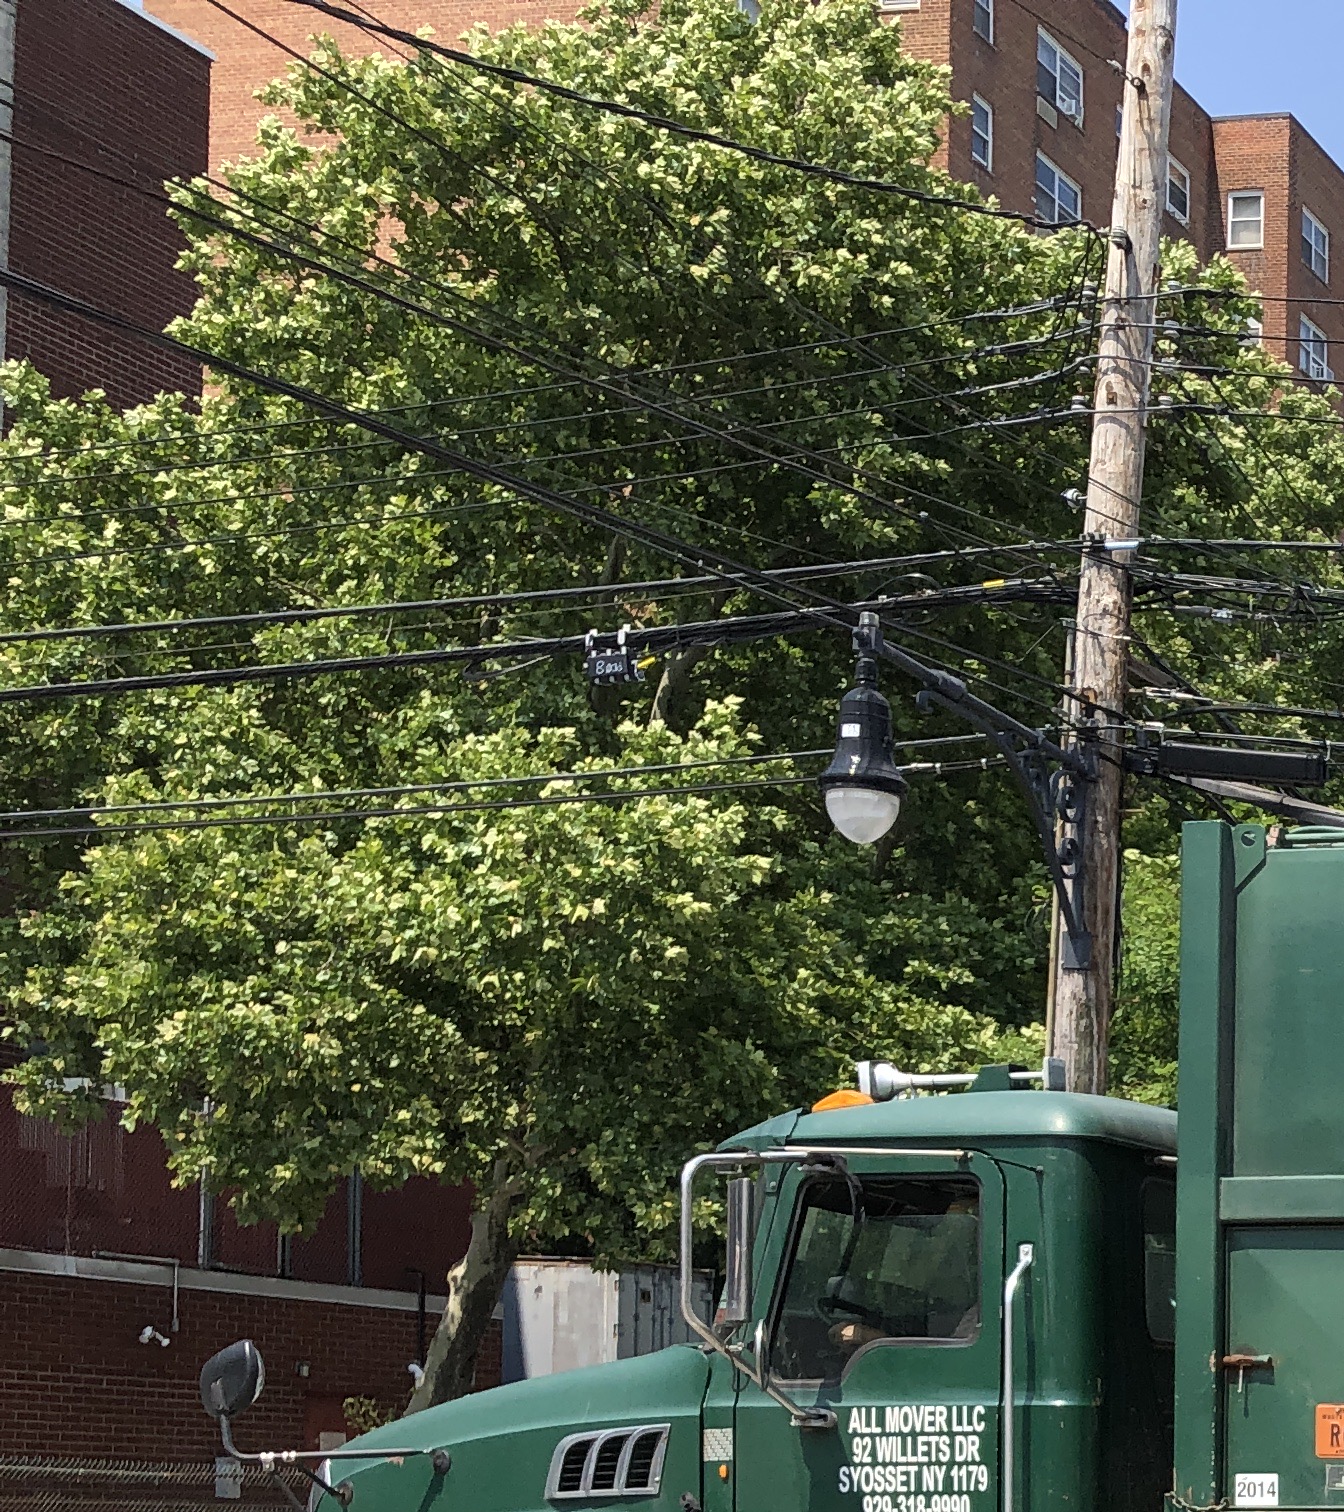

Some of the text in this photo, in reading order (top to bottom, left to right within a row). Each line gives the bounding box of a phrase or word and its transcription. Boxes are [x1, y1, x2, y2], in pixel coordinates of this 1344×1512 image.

[847, 1405, 986, 1434] ALL MOVER LLC
[852, 1435, 981, 1463] 92 WILLETS DR
[838, 1464, 988, 1493] SYOSSET NY 1179
[1237, 1481, 1276, 1498] 2014
